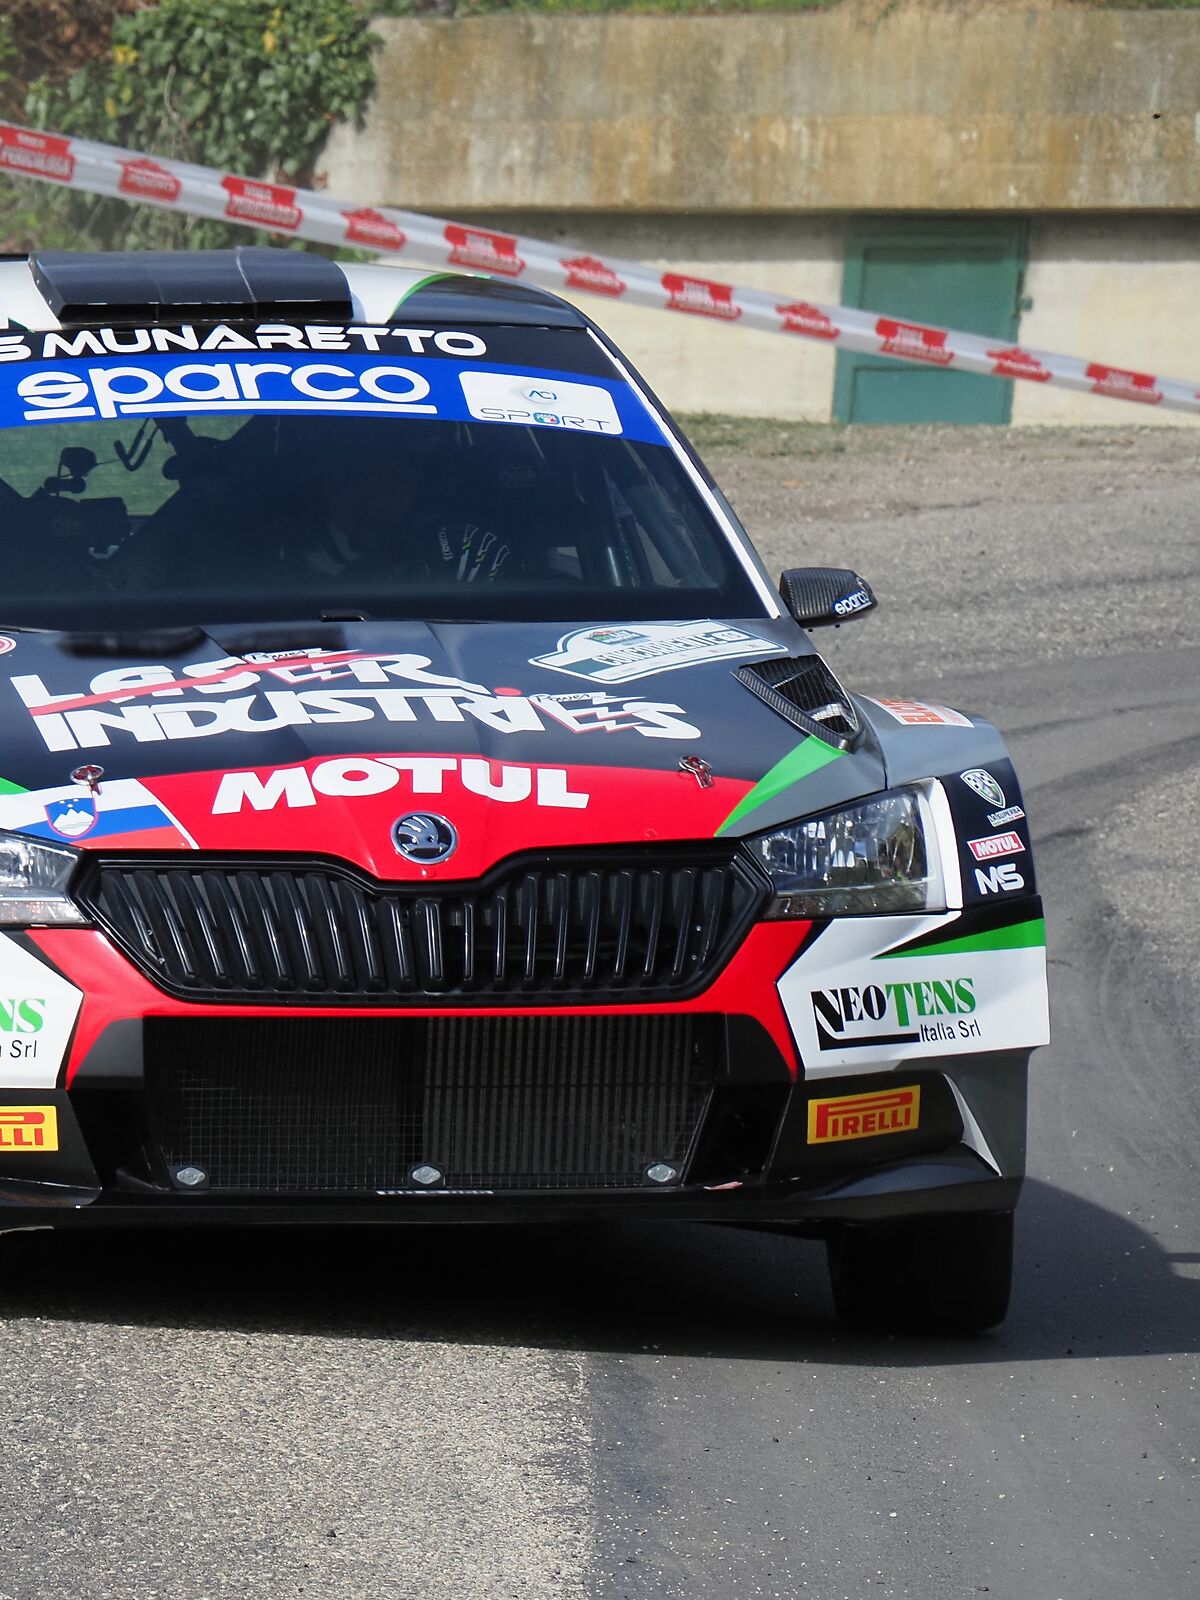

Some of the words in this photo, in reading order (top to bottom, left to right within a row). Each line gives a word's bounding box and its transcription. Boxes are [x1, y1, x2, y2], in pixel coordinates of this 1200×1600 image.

[43, 324, 487, 358] MUNARETTO
[17, 363, 438, 419] sparco
[10, 652, 491, 708] LASER
[32, 687, 702, 752] INDUSTRIES
[212, 758, 590, 815] MOTUL
[975, 834, 1019, 857] MOTUL
[974, 863, 1025, 895] MS
[811, 978, 976, 1045] NEOTENS
[920, 1022, 956, 1043] Italia
[959, 1019, 982, 1039] Srl
[9, 1039, 38, 1058] Srl
[815, 1091, 914, 1138] PIRELLI
